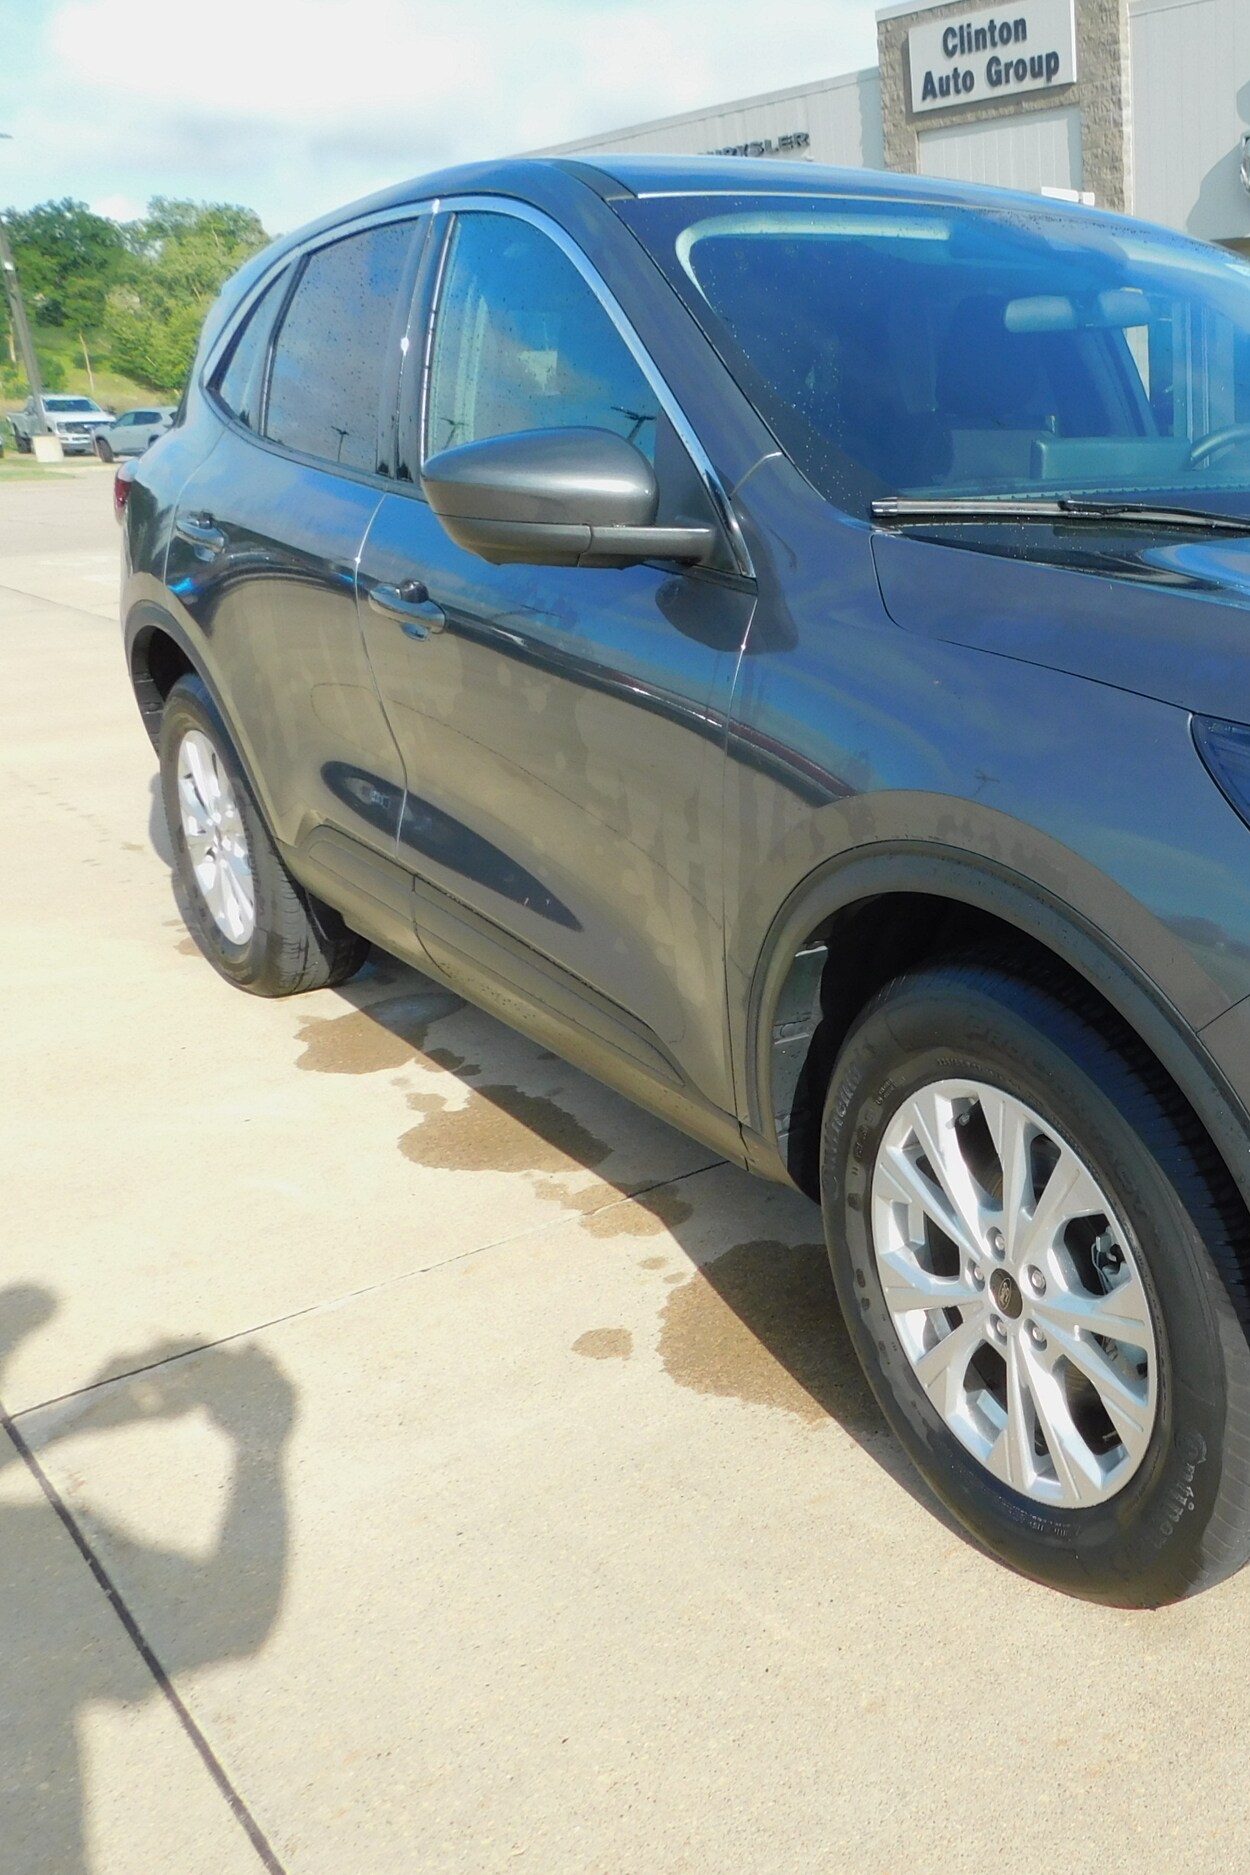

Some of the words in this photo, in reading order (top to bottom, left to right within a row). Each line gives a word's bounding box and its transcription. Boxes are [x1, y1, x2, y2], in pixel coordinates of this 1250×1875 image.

[943, 17, 1027, 58] Clinton
[922, 67, 975, 101] Auto
[986, 50, 1060, 88] Group
